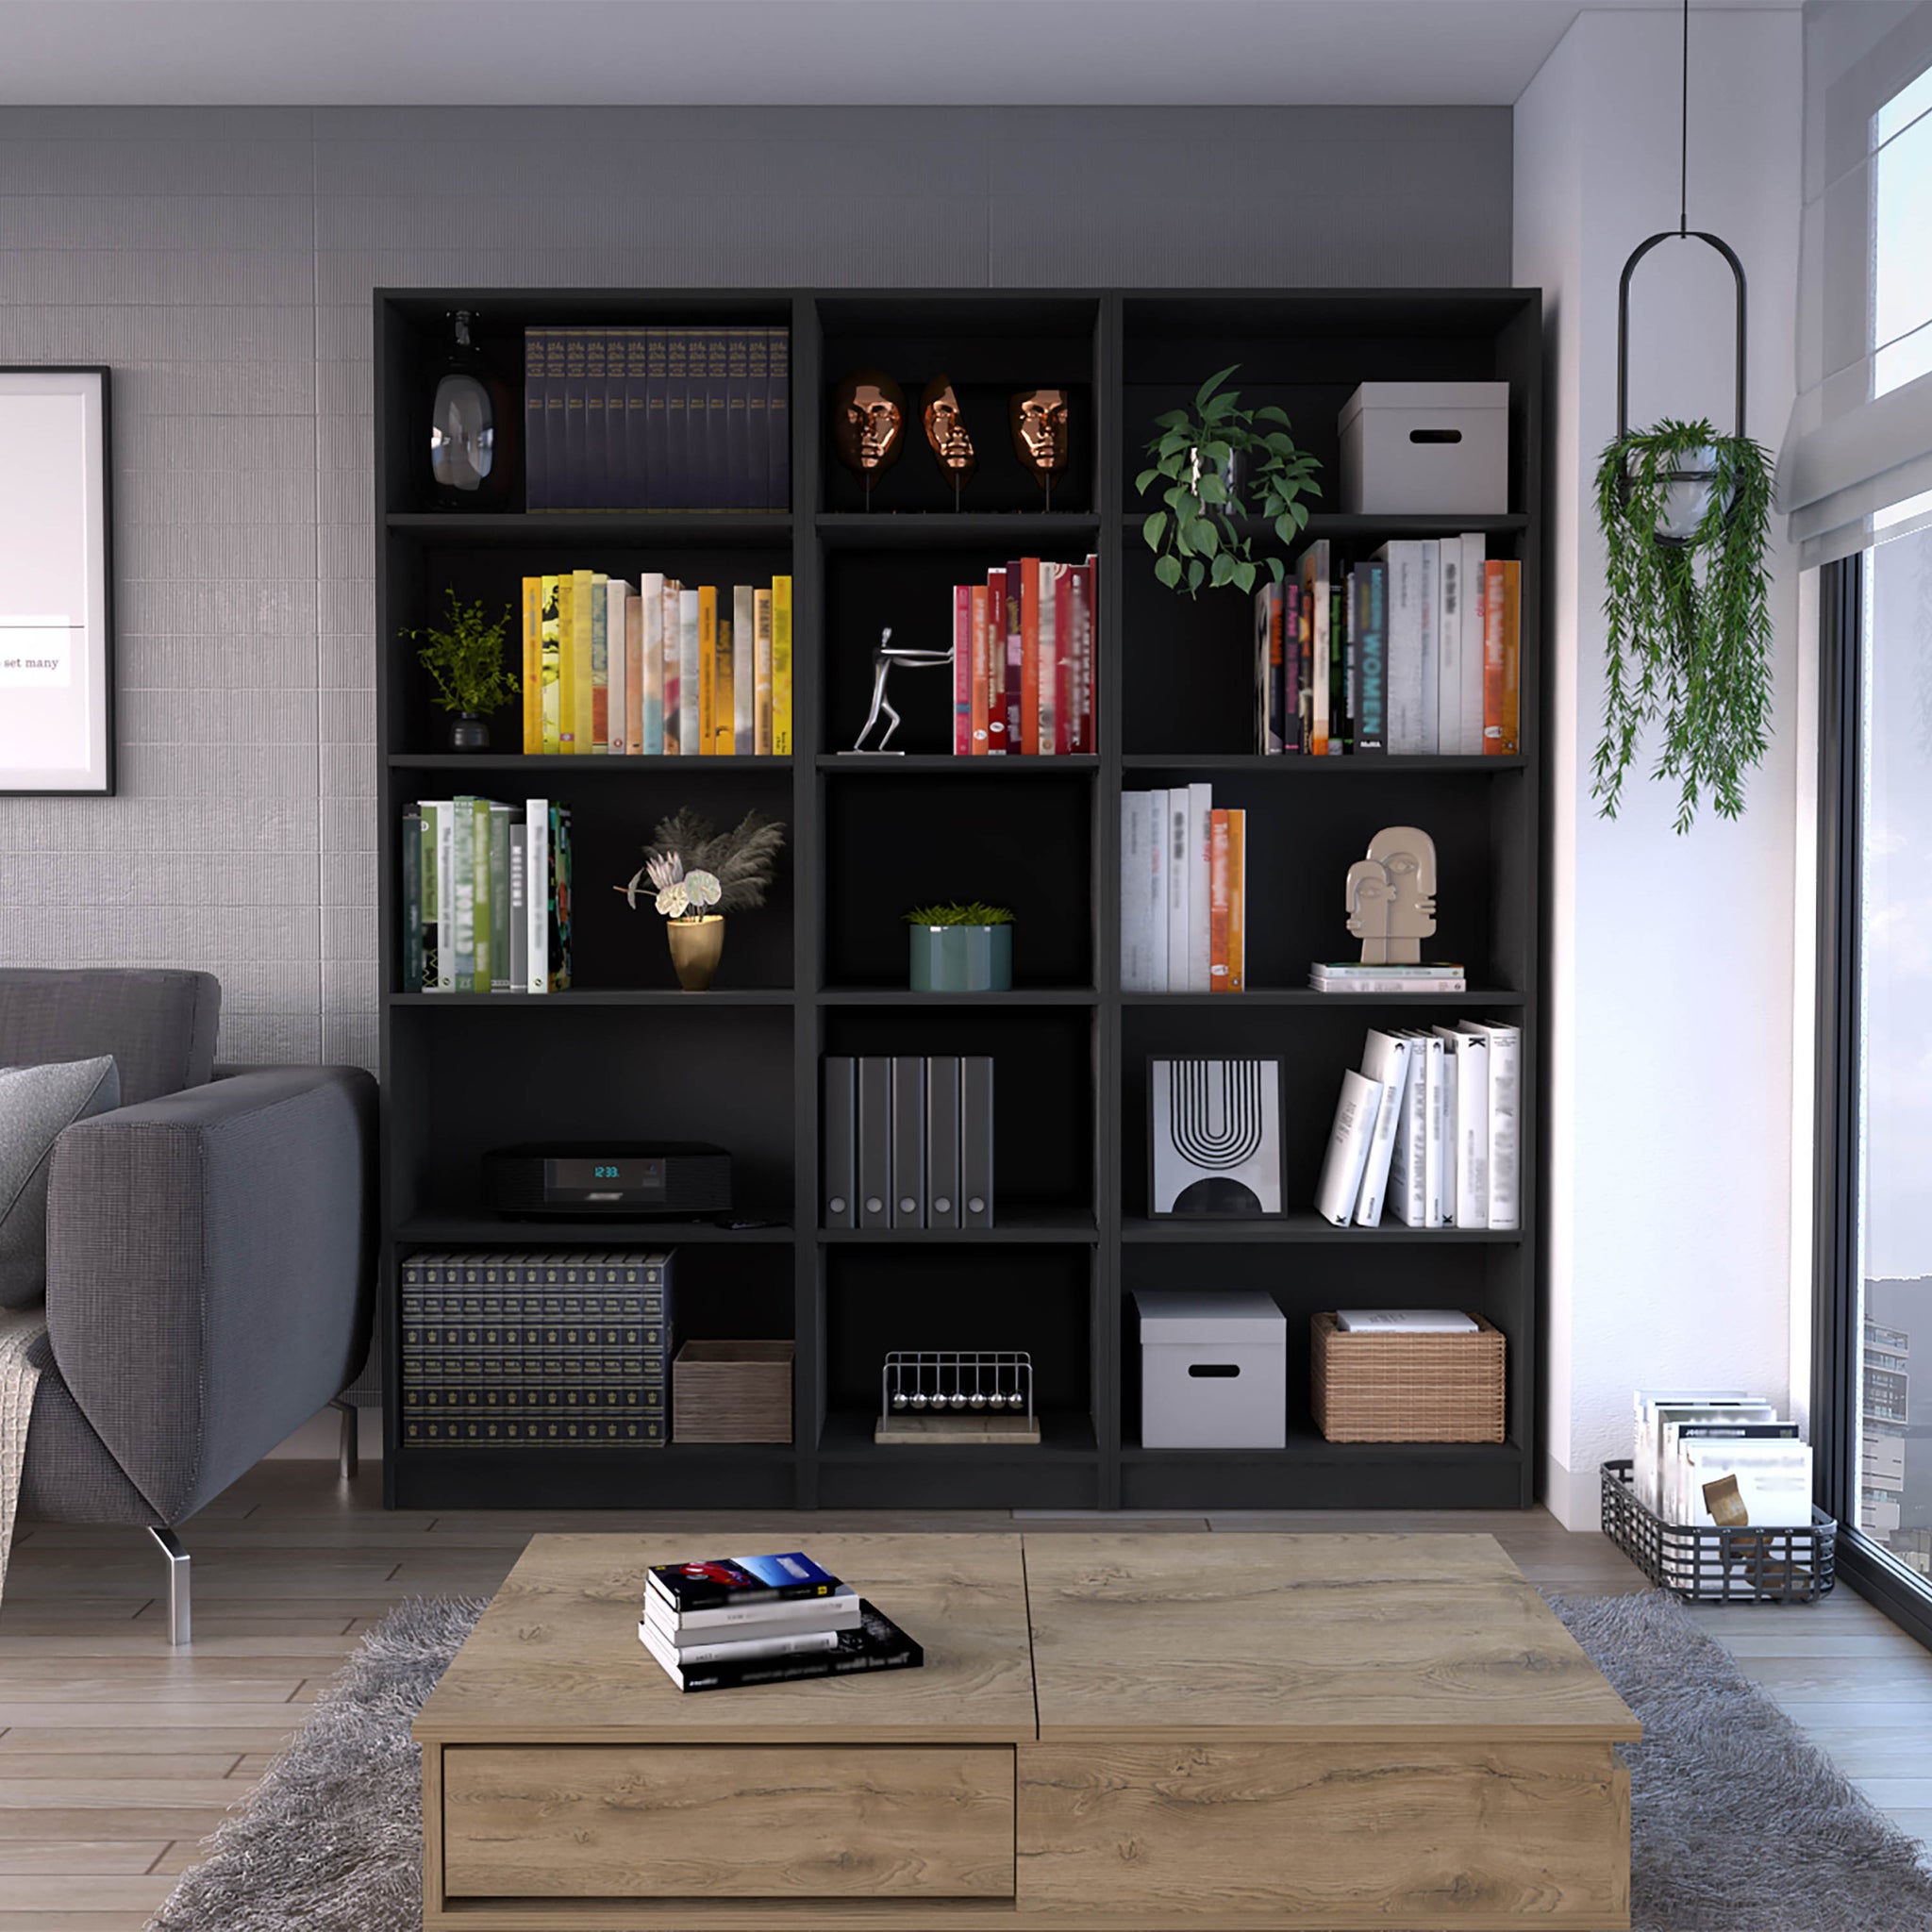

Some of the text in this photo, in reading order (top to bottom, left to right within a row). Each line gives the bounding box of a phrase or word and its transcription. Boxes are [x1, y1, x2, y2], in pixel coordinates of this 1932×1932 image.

[4, 658, 59, 671] set many
[1362, 633, 1382, 734] WOMEN
[1468, 1037, 1486, 1048] K
